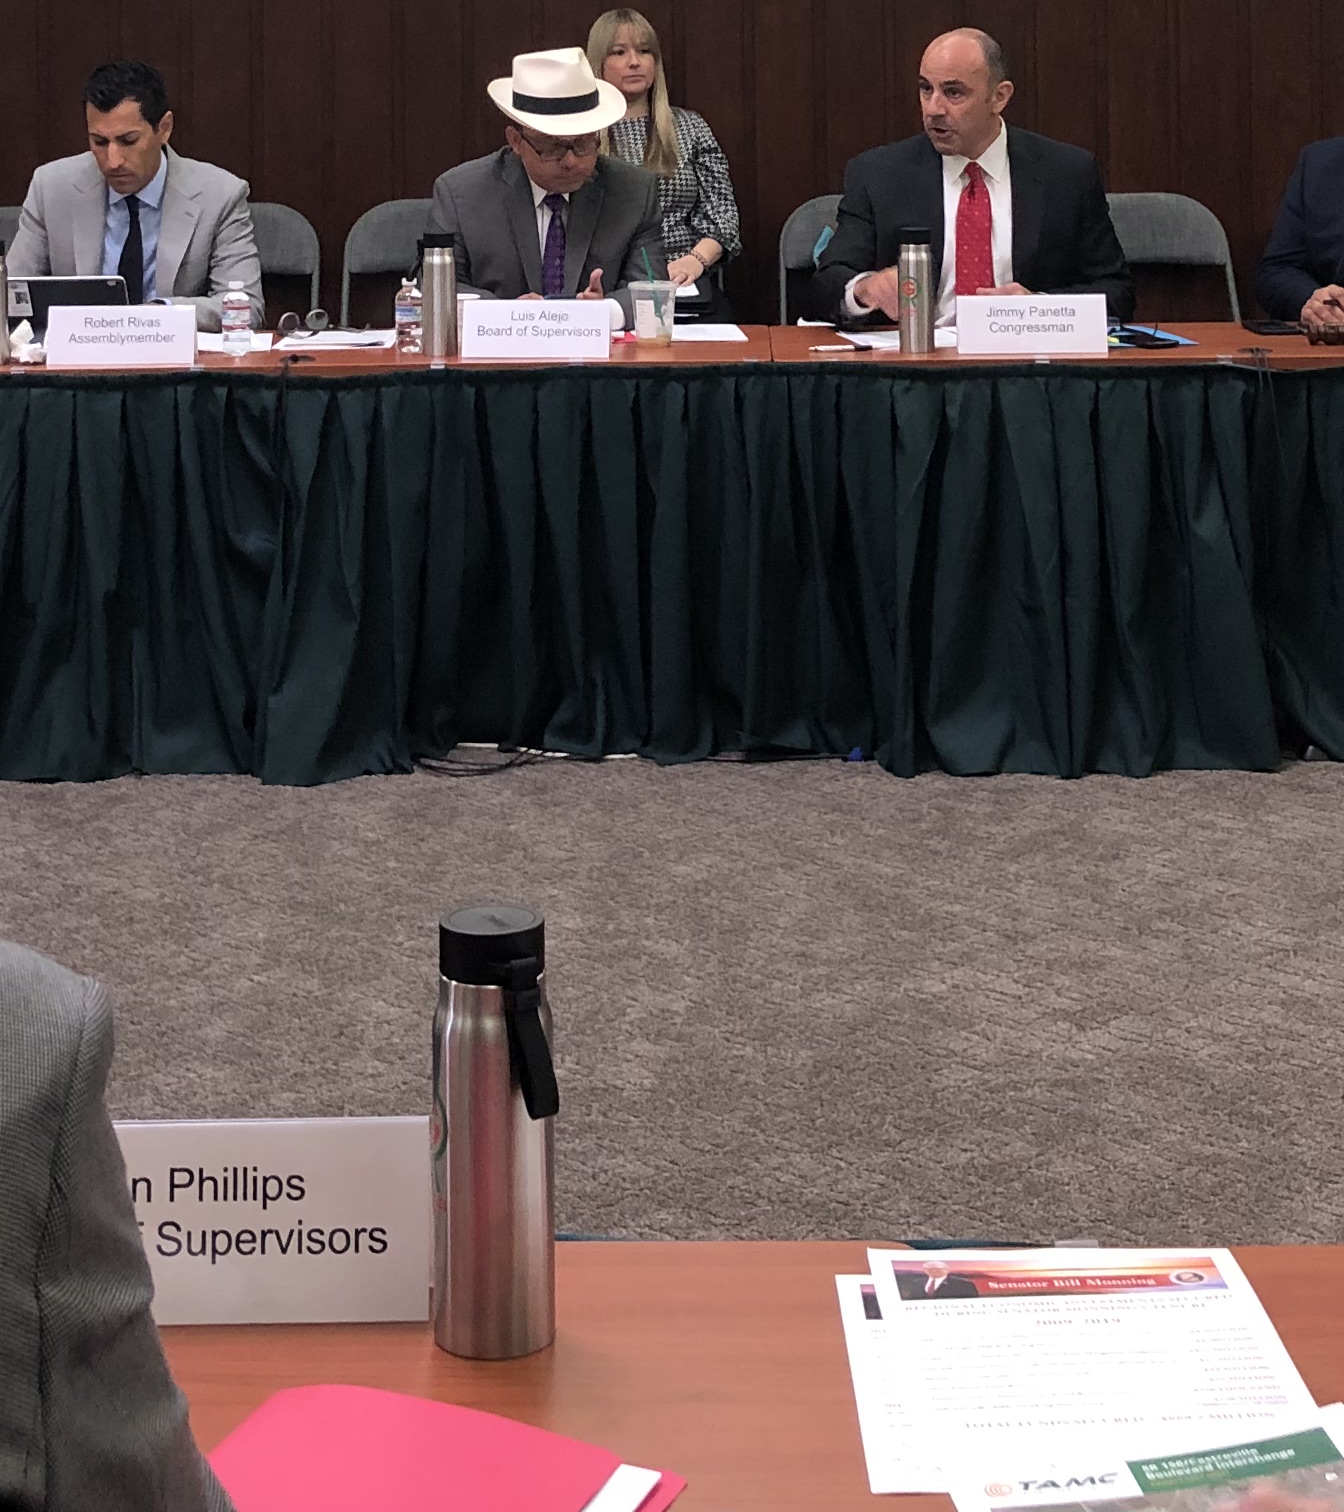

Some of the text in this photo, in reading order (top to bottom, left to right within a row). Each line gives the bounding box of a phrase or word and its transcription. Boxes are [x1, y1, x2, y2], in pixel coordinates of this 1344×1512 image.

[511, 310, 569, 324] Luis Alejo
[986, 306, 1076, 320] Jimmy Panetta
[84, 316, 162, 329] Robert Rivas
[989, 321, 1074, 336] Congressman
[67, 332, 176, 346] Assemblymember
[477, 325, 602, 339] Board of Supervisors
[169, 1166, 306, 1211] Phillips
[156, 1219, 389, 1265] Supervisors
[987, 1277, 1157, 1289] Senator Bill Monning
[1144, 1464, 1215, 1481] Boulevard
[1215, 1448, 1297, 1470] Interchange
[1017, 1471, 1118, 1492] TAMC
